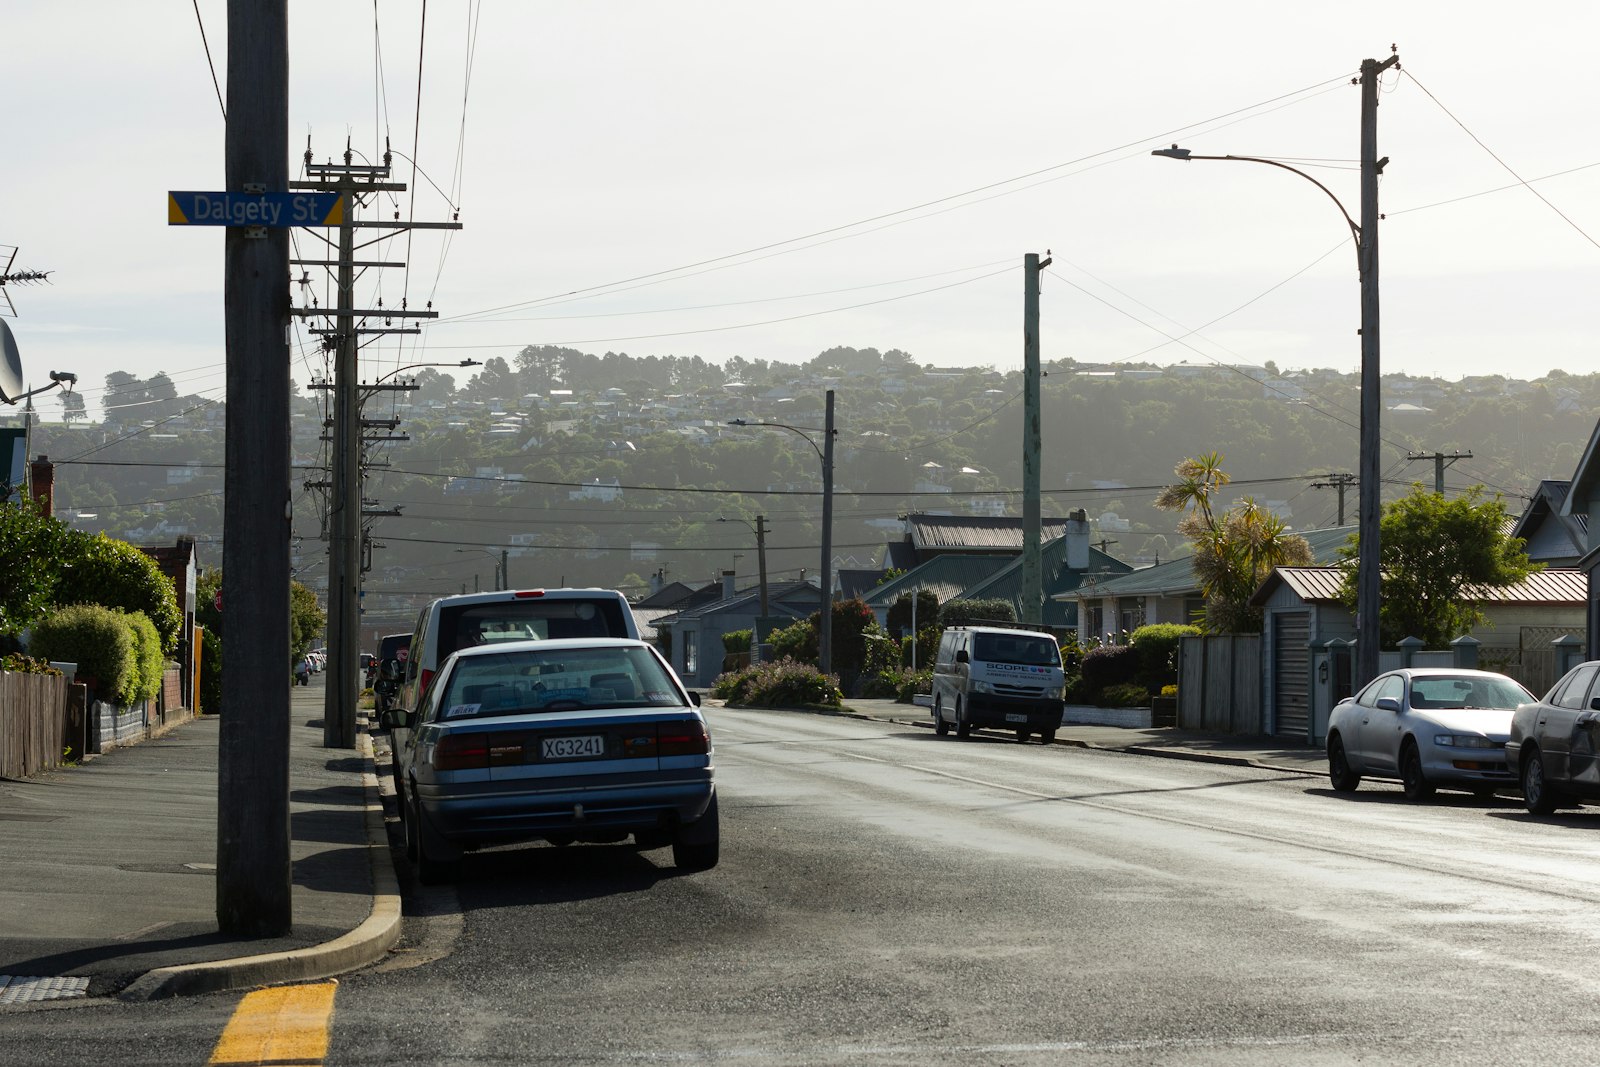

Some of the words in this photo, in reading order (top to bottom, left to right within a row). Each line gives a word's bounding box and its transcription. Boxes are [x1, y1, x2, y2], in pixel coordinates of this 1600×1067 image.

[194, 195, 282, 225] Dalgety
[292, 195, 318, 221] St
[986, 663, 1029, 672] SCOPE
[544, 737, 601, 758] XG3241
